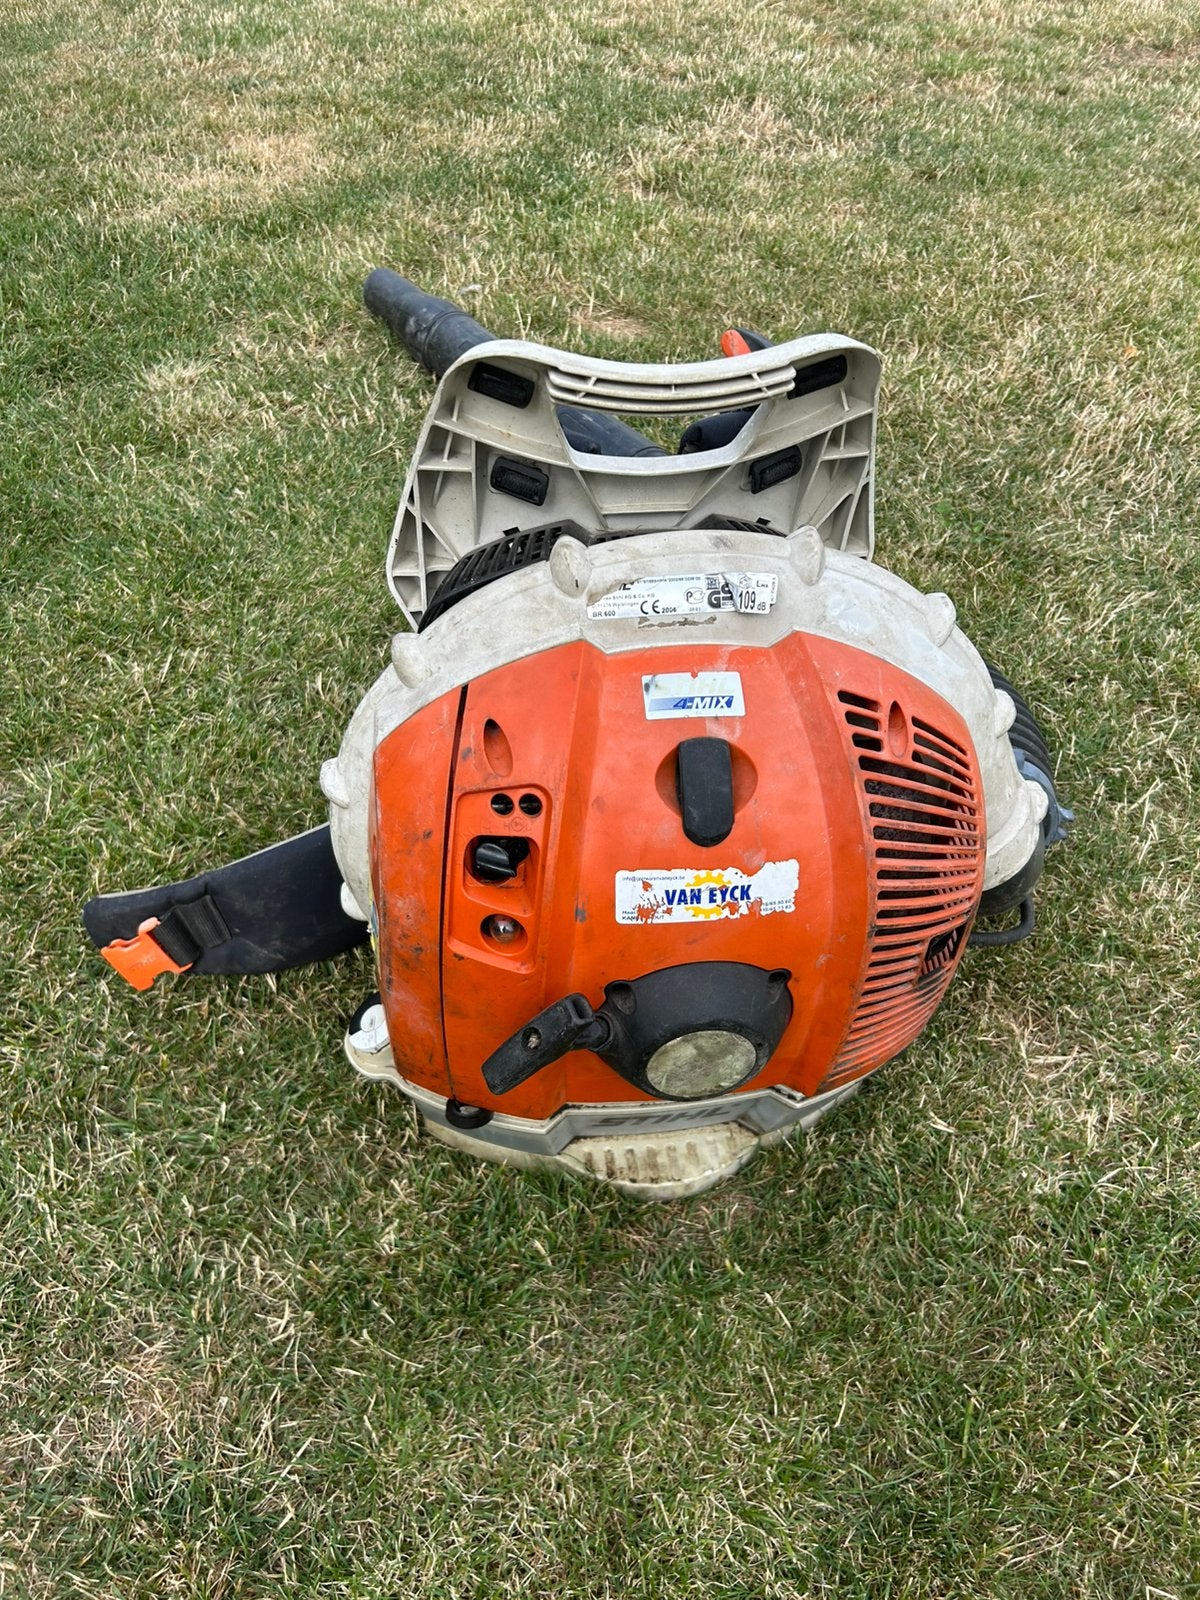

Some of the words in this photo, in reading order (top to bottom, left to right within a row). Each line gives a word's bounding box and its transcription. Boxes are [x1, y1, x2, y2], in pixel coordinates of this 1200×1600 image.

[662, 606, 677, 614] 2006
[739, 590, 756, 610] 109
[757, 601, 767, 611] dB
[673, 696, 730, 710] 4-MIX
[664, 888, 702, 906] VAN
[708, 884, 752, 904] EYCK
[592, 1106, 731, 1127] STIHL
